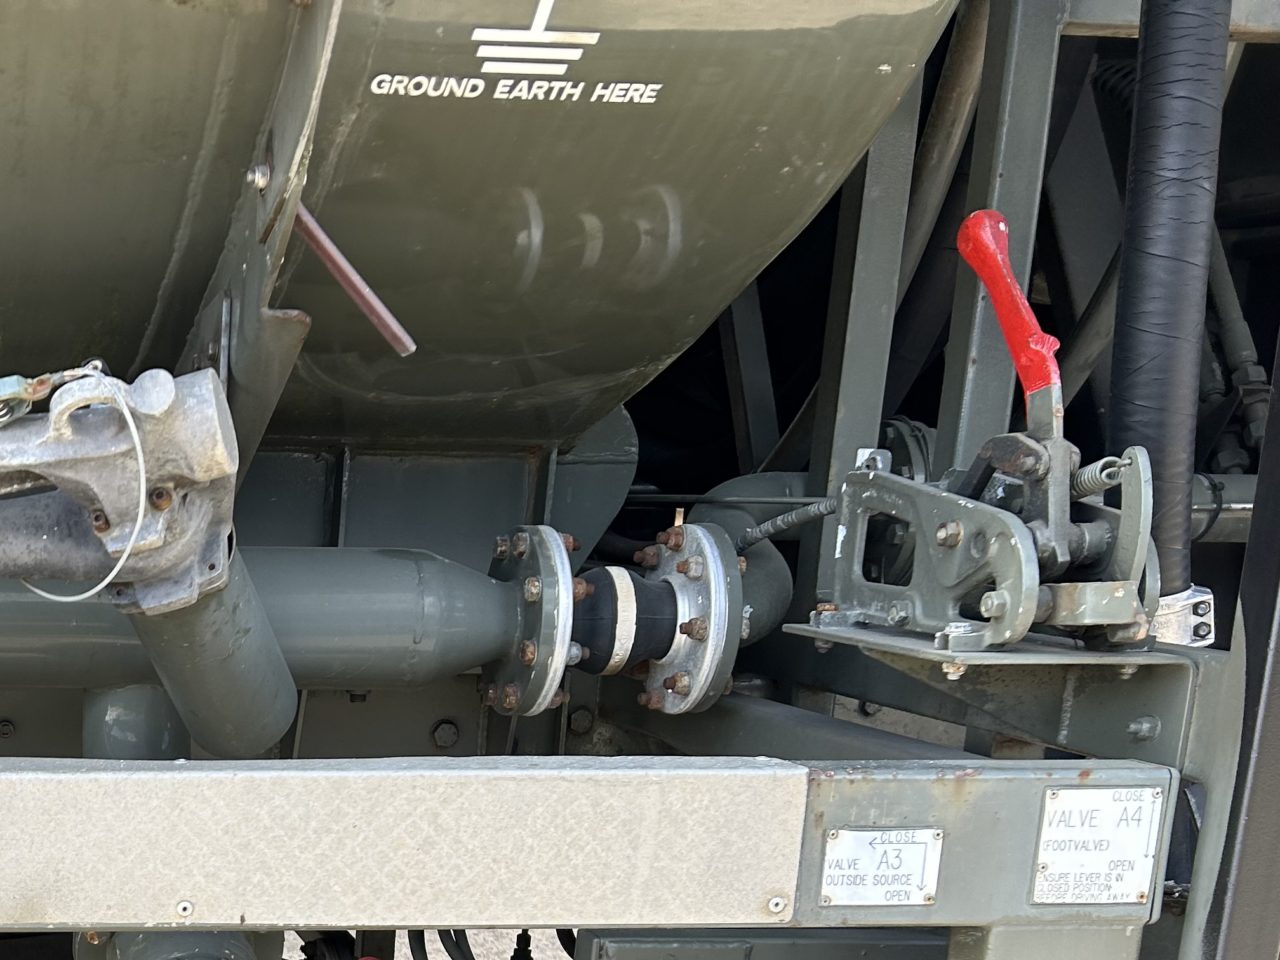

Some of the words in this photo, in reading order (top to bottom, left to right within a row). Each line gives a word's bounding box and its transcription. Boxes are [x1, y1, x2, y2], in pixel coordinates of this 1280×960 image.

[370, 74, 485, 98] GROUND
[493, 79, 583, 101] EARTH
[589, 82, 664, 104] HERE
[1111, 790, 1145, 802] CLOSE
[1047, 809, 1101, 828] VALVE
[1117, 805, 1143, 828] A4
[880, 831, 918, 843] CLOSE
[1043, 839, 1110, 851] (FOOTVALVE)
[827, 859, 861, 871] VALVE
[876, 848, 902, 870] A3
[1108, 860, 1135, 871] OPEN
[825, 874, 869, 886] OUTSIDE
[872, 873, 913, 886] SOURCE
[1073, 872, 1102, 882] LEVER
[1104, 872, 1112, 882] IS
[1115, 872, 1125, 882] IN
[1073, 883, 1113, 893] POSITION
[884, 890, 911, 901] OPEN
